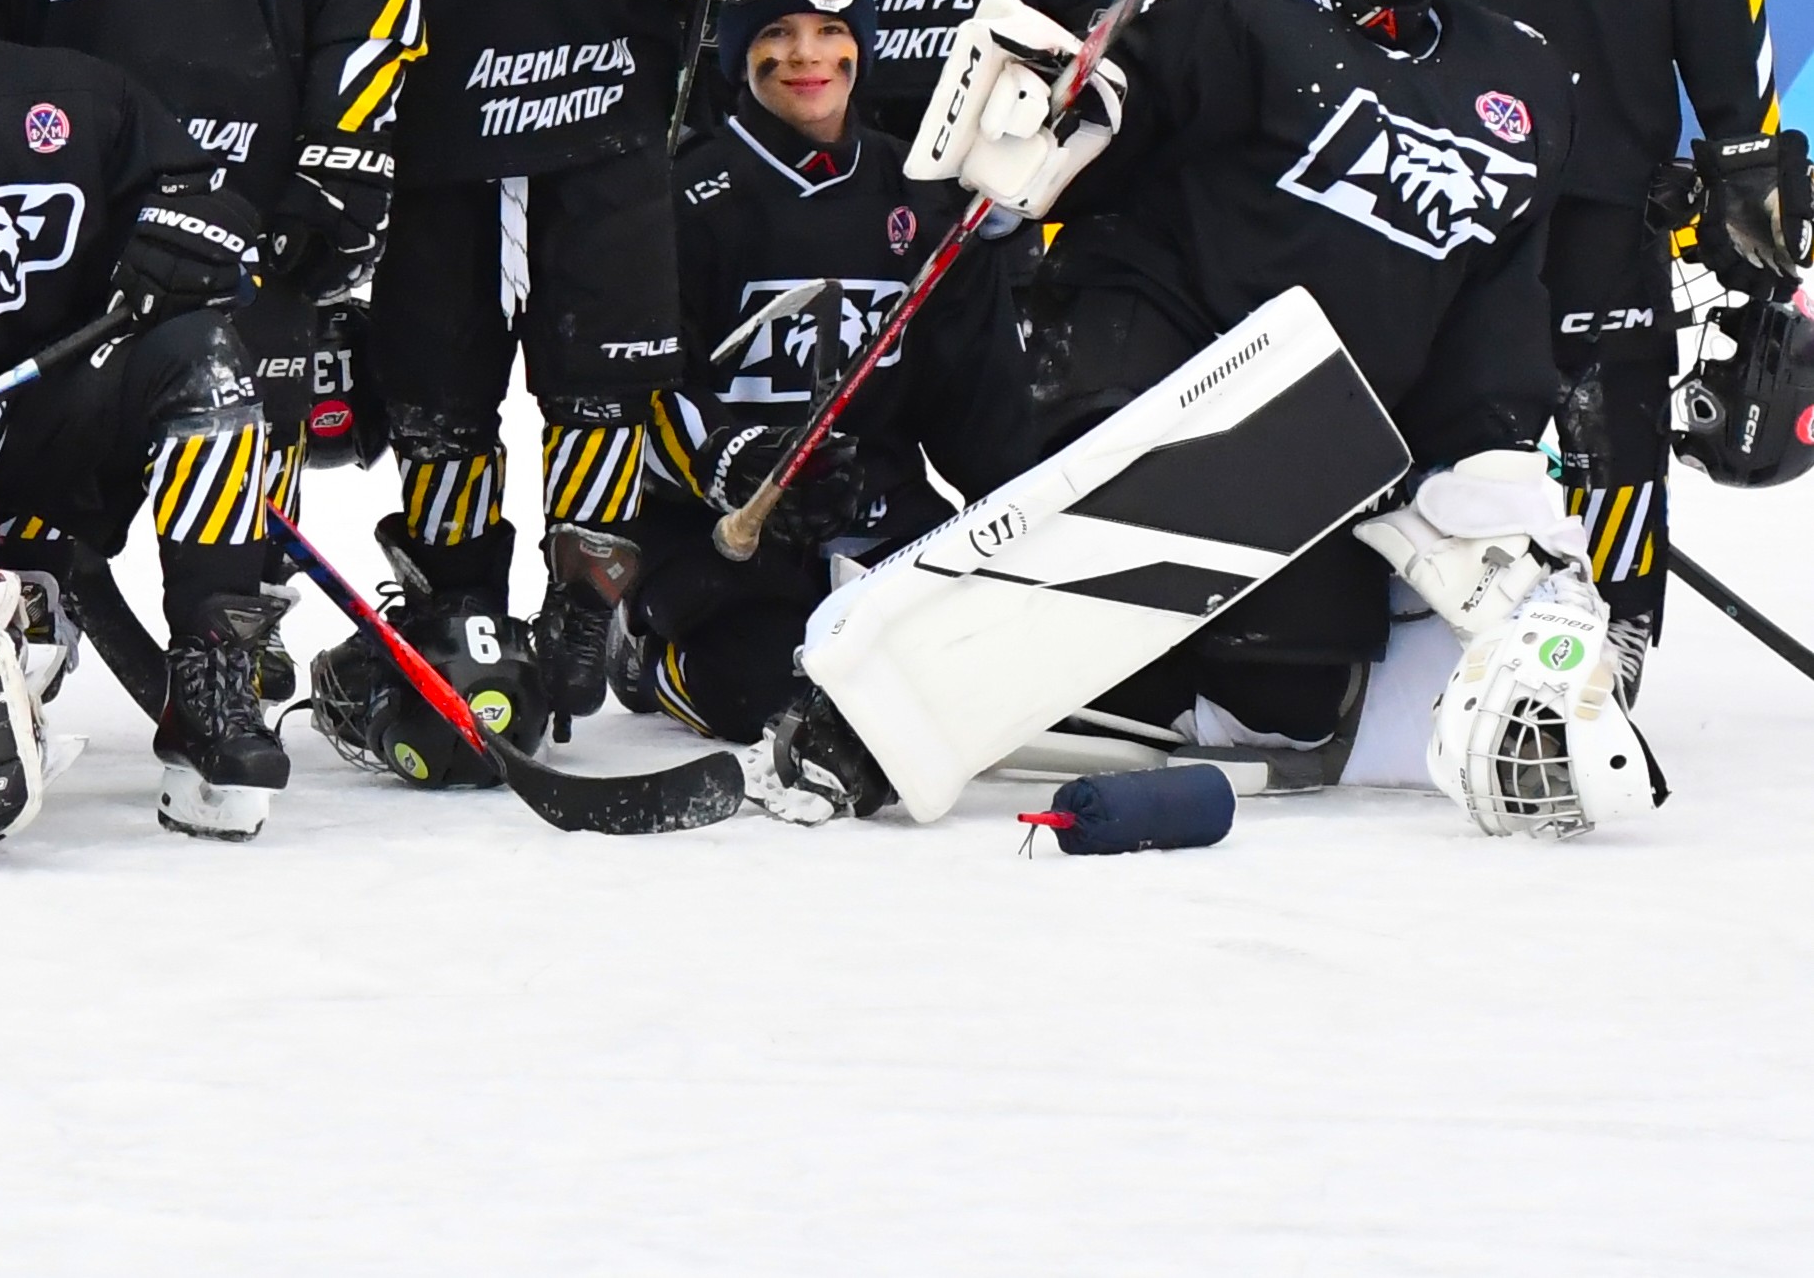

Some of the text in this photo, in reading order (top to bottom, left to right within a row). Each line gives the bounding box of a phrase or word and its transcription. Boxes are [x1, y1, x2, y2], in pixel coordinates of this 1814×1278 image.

[931, 44, 983, 163] CCM
[298, 143, 395, 178] BAUE
[1721, 137, 1771, 157] CCM
[1560, 307, 1655, 334] CCM
[600, 336, 681, 361] TRUE
[1179, 332, 1271, 409] WARRIOR
[1740, 403, 1761, 455] CCM
[1529, 611, 1595, 632] BAUER
